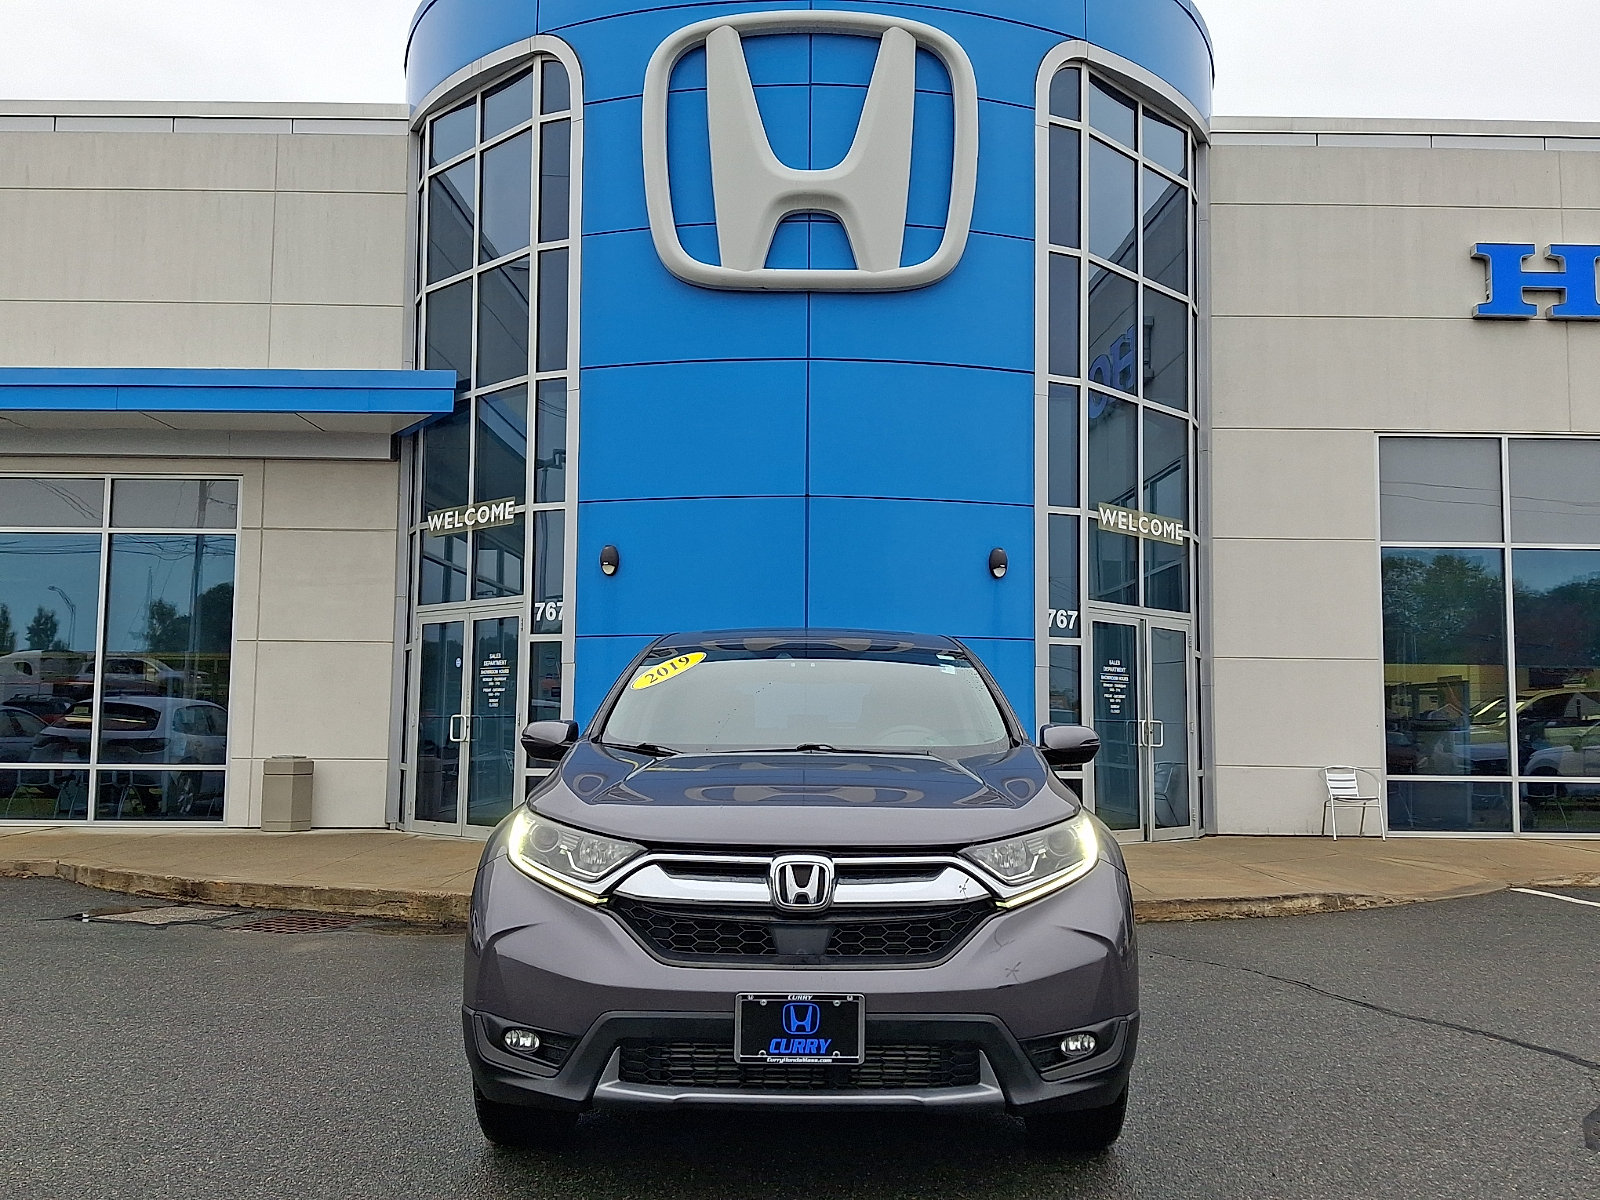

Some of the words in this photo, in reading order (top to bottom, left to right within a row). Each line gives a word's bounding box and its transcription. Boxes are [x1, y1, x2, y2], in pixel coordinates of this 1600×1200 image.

[428, 501, 515, 532] WELCOME
[1098, 507, 1184, 541] WELCOME
[535, 602, 563, 621] 767
[1048, 609, 1078, 629] 767
[644, 656, 690, 684] 2019
[769, 1038, 832, 1054] CURRY
